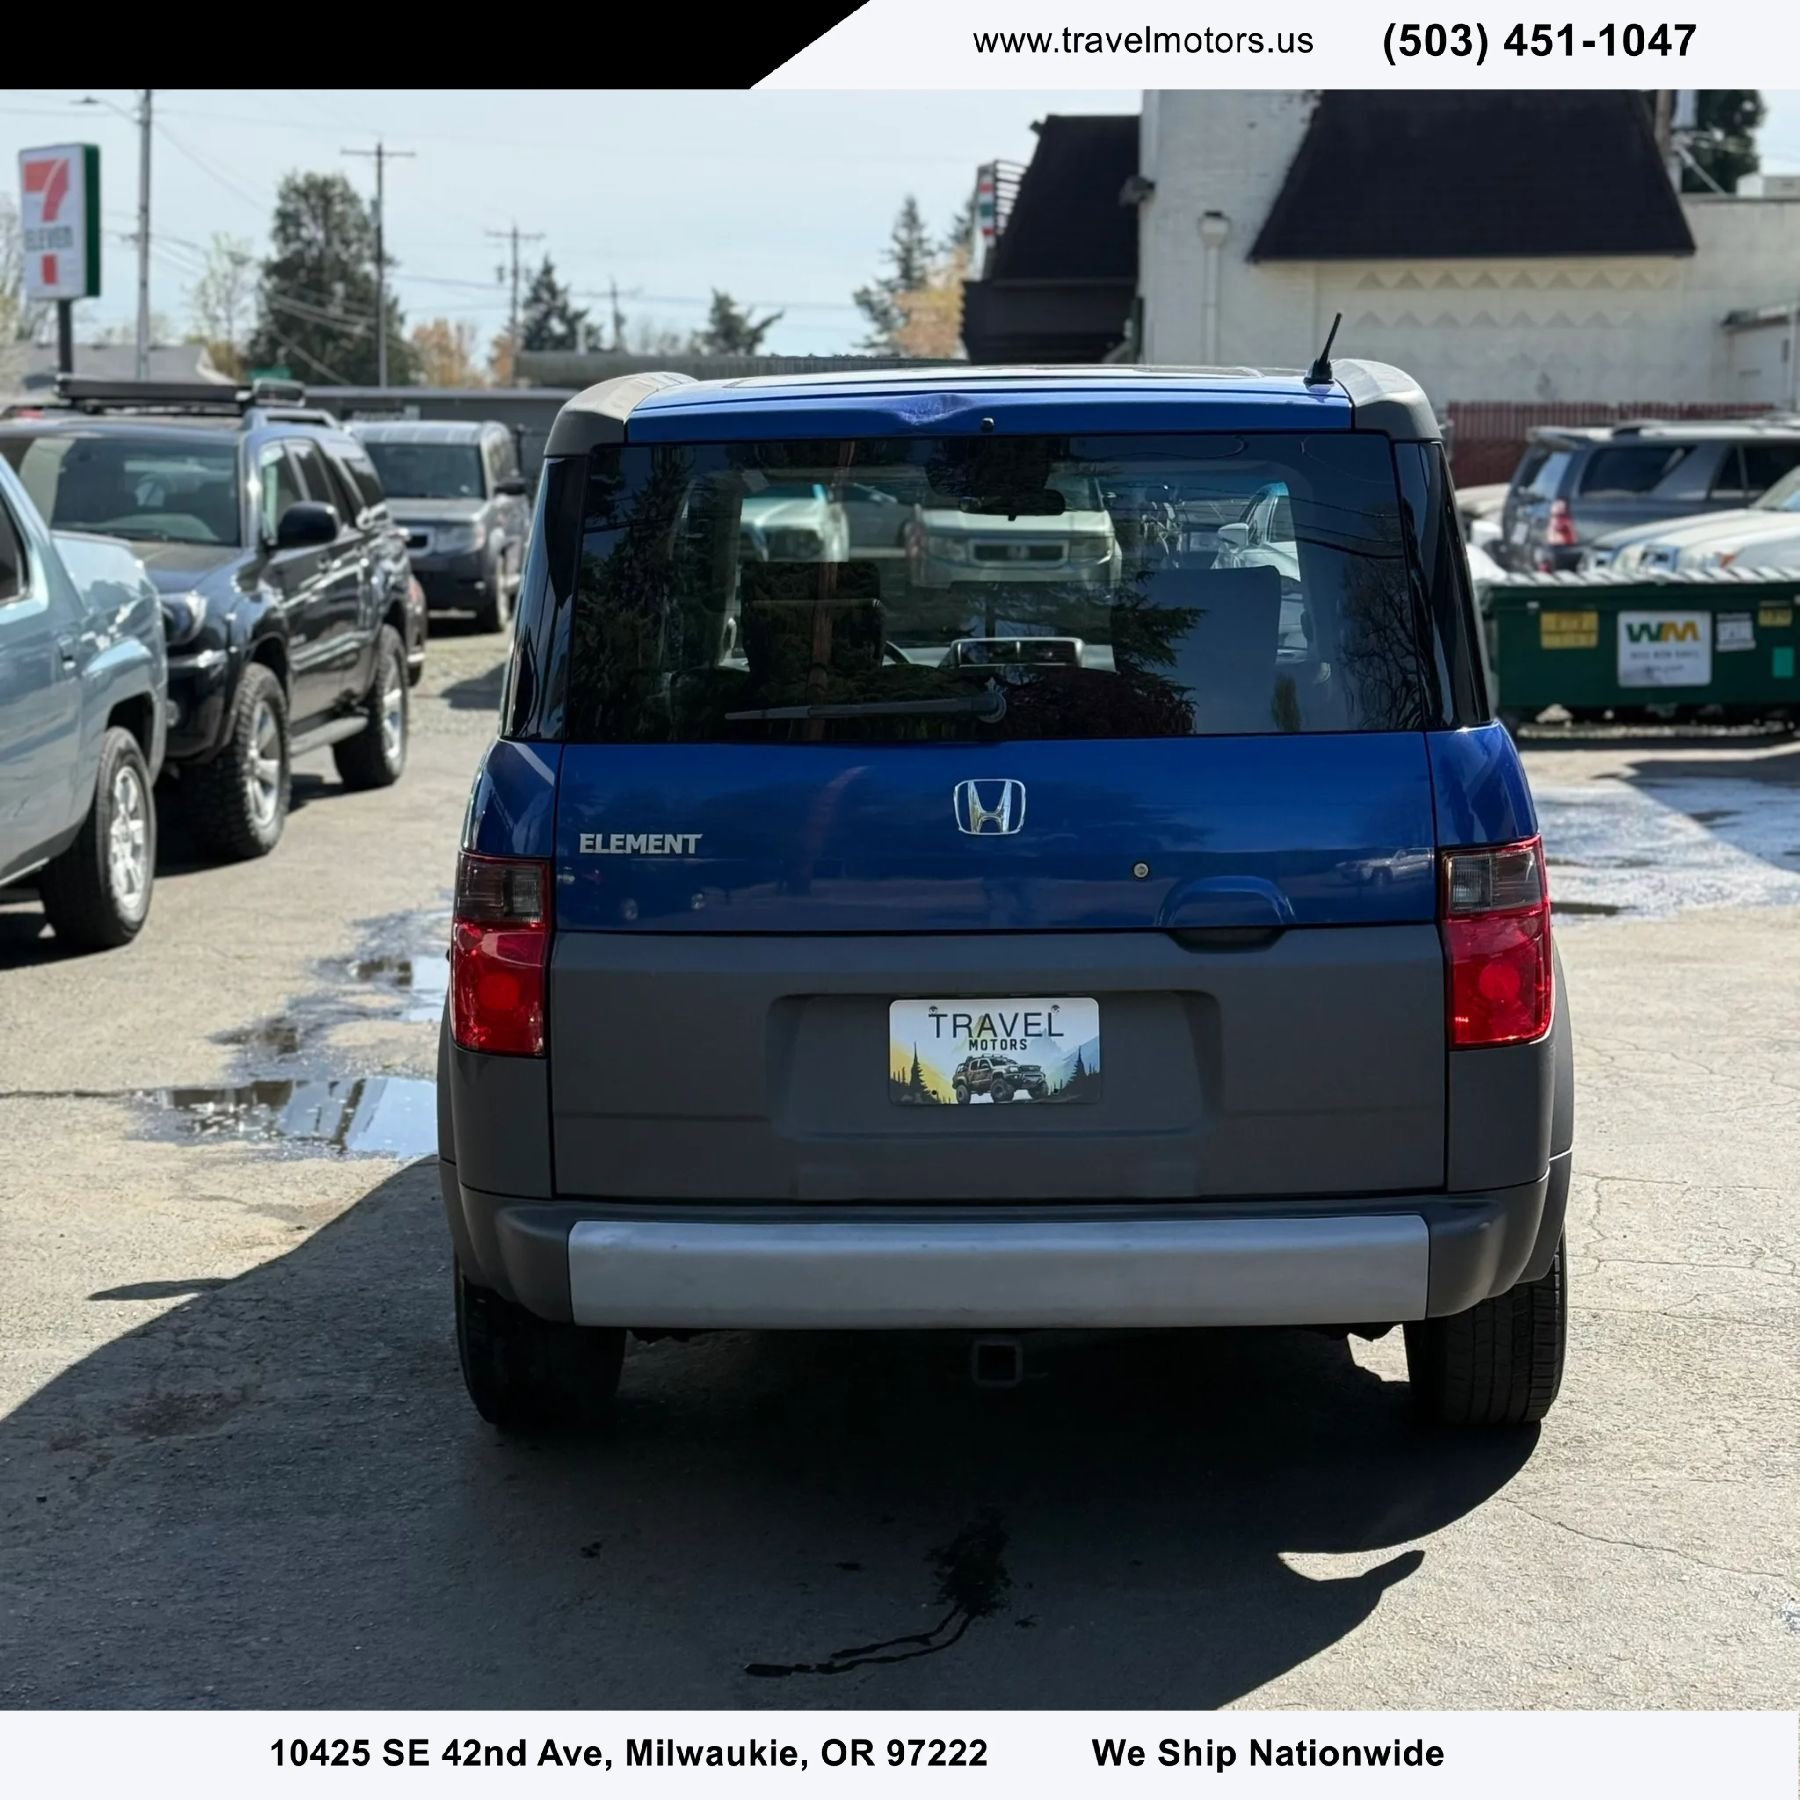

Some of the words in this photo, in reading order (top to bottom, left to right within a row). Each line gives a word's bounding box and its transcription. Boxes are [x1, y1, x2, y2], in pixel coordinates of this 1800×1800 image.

[1625, 620, 1700, 643] WM
[579, 832, 703, 856] ELEMENT
[928, 1012, 1064, 1038] TRAVEL
[968, 1038, 1027, 1051] MOTORS
